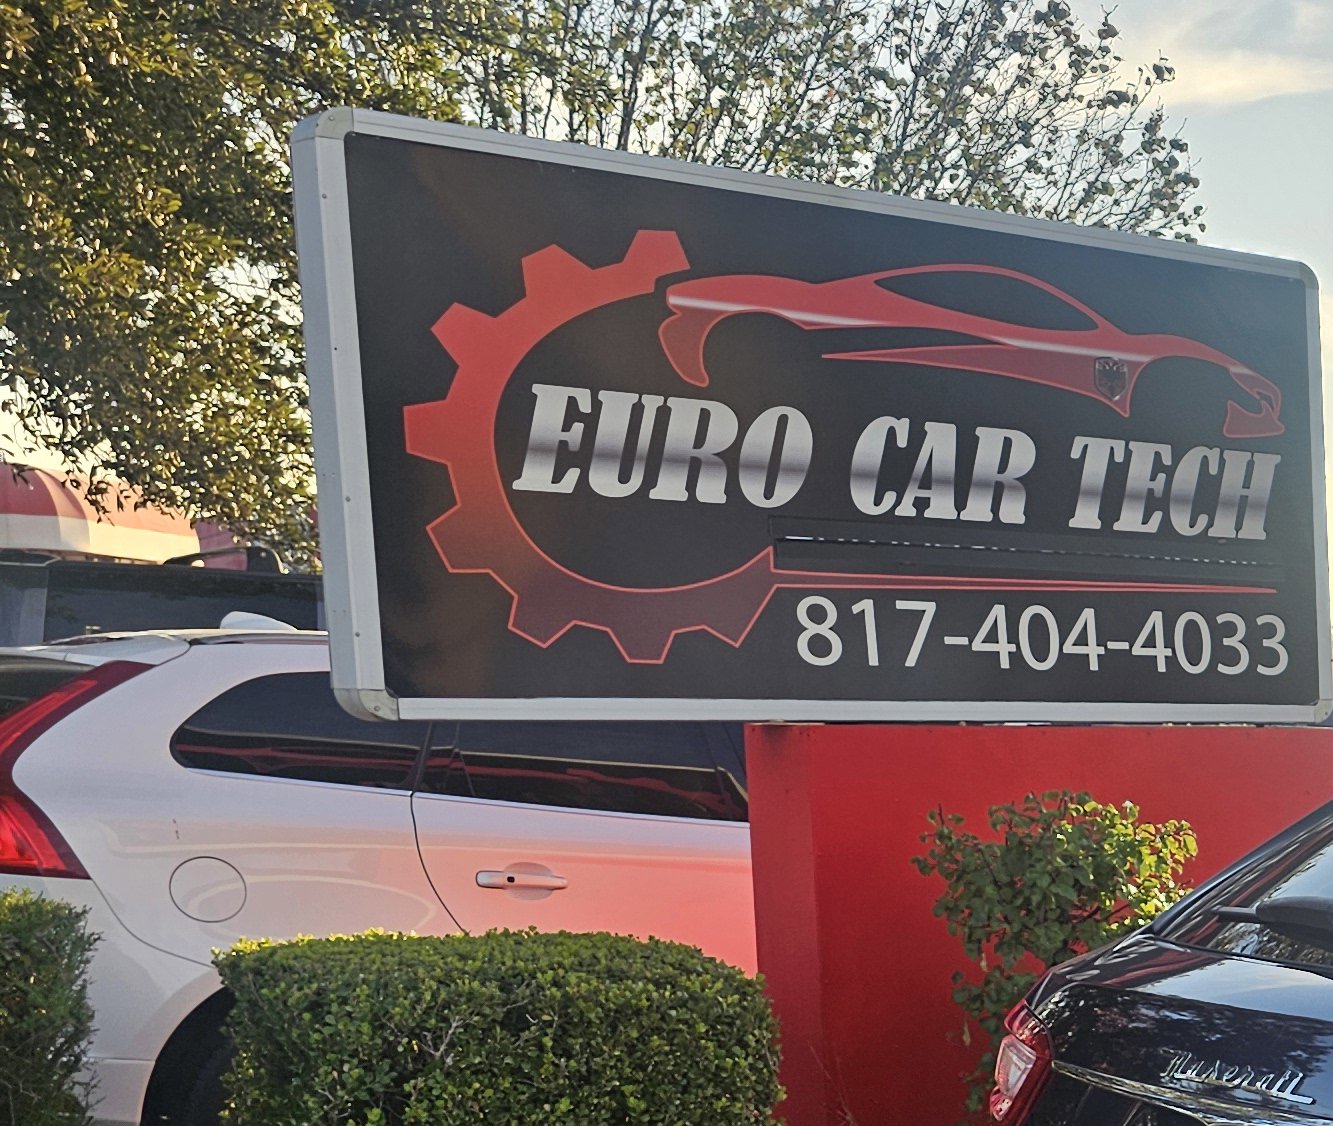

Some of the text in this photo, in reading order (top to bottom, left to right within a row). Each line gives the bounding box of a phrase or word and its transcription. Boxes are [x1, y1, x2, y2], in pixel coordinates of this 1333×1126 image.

[512, 383, 1282, 540] EURO CAR TECH
[796, 595, 1290, 676] 817-404-4033
